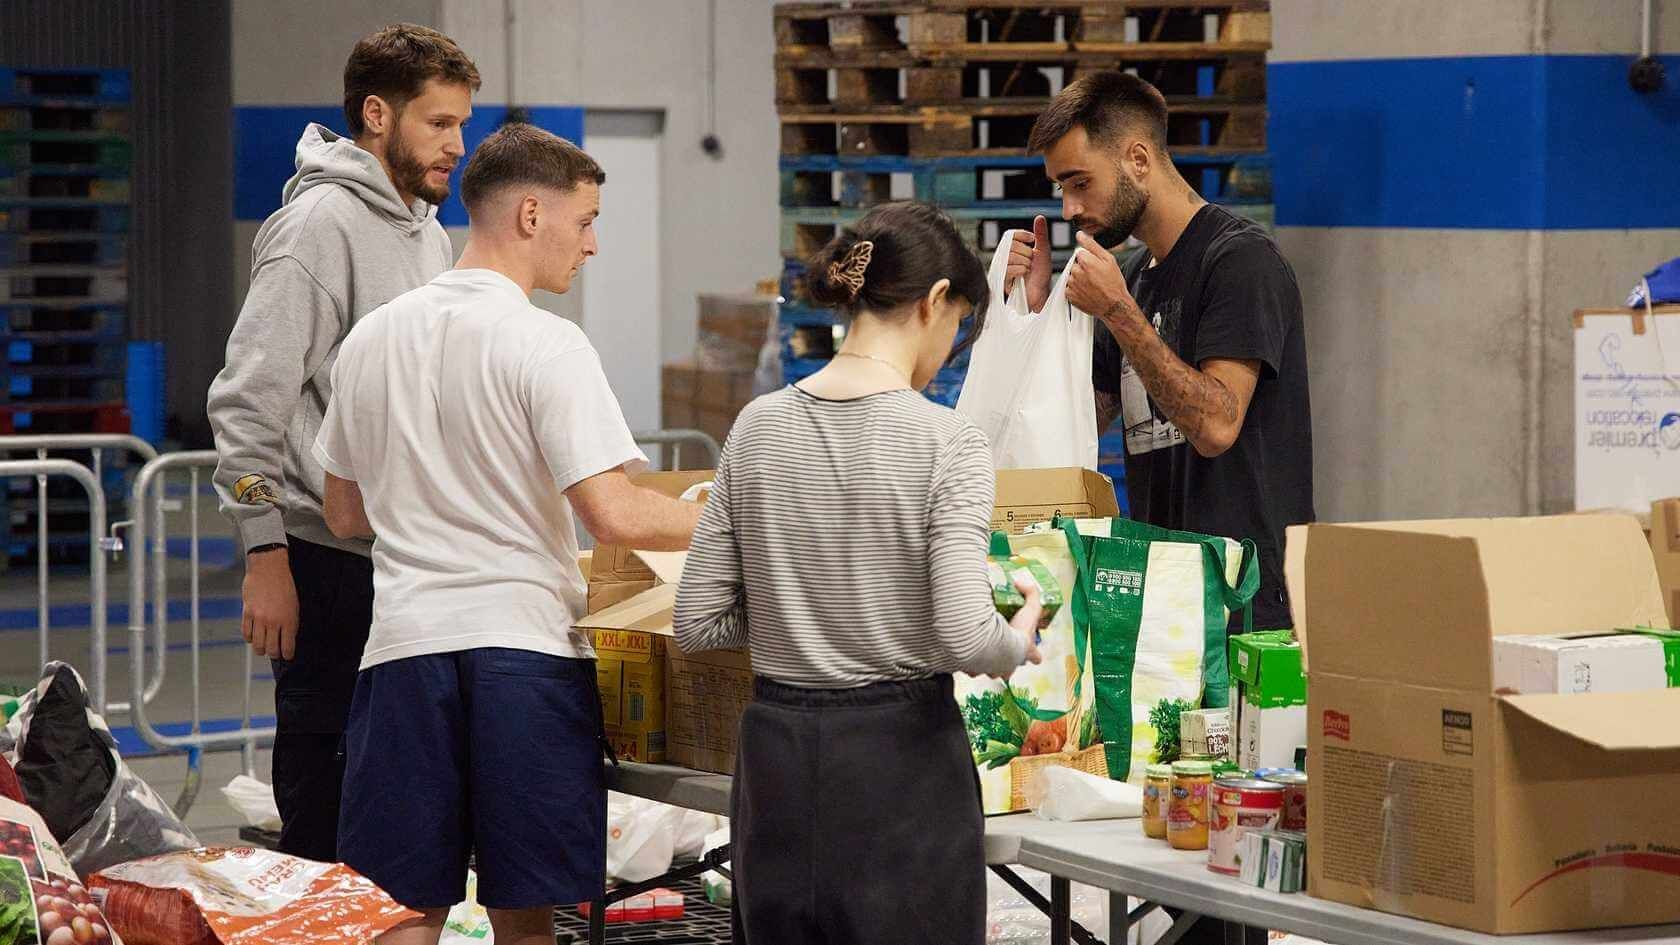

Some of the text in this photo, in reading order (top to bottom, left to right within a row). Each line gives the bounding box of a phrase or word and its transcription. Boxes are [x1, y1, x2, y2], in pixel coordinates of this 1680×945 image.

[1585, 410, 1658, 429] relocation
[1588, 429, 1660, 453] premier
[1006, 510, 1014, 522] 5
[601, 632, 621, 648] XXL
[626, 634, 648, 649] XXL
